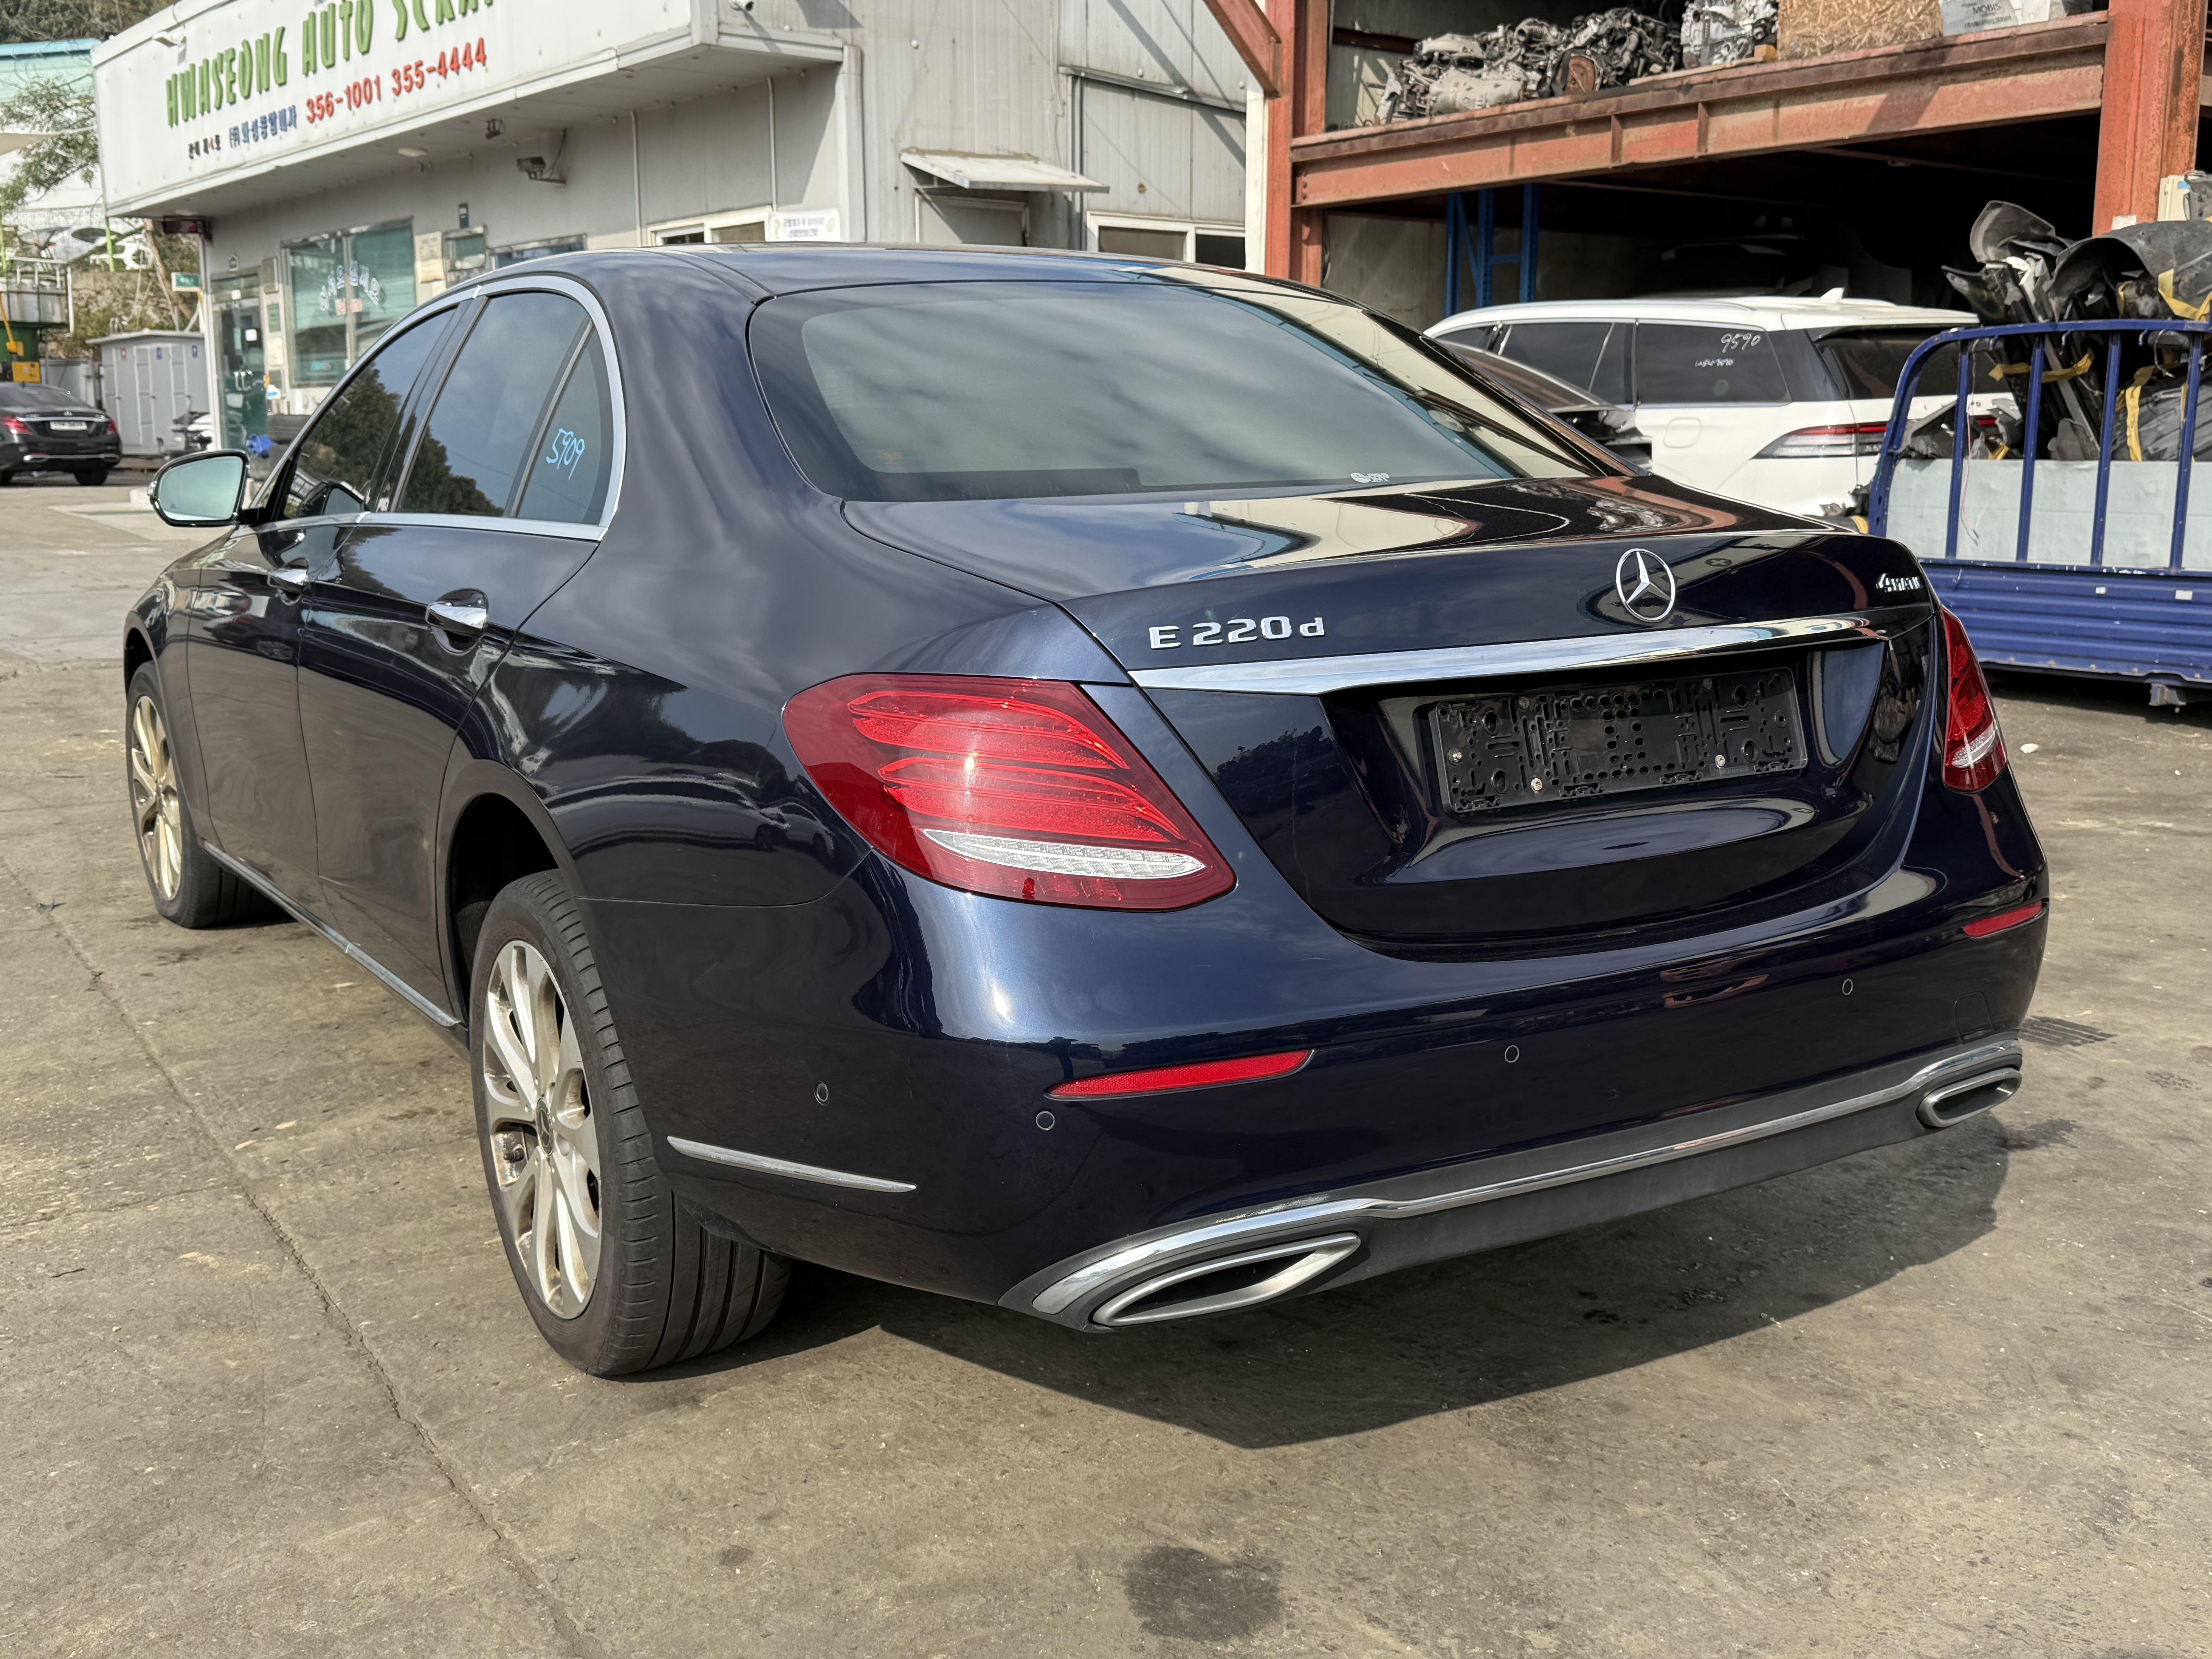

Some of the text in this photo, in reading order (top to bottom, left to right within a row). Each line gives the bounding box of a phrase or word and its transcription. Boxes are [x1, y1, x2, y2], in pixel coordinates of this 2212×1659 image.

[1973, 2, 2001, 14] MOBIS
[166, 26, 287, 128] HWASEONG
[302, 0, 373, 77] AUTO
[306, 37, 487, 124] 356-1001 355-4444
[1721, 333, 1761, 353] 9590
[546, 428, 586, 481] 5909
[1149, 625, 1182, 650] E
